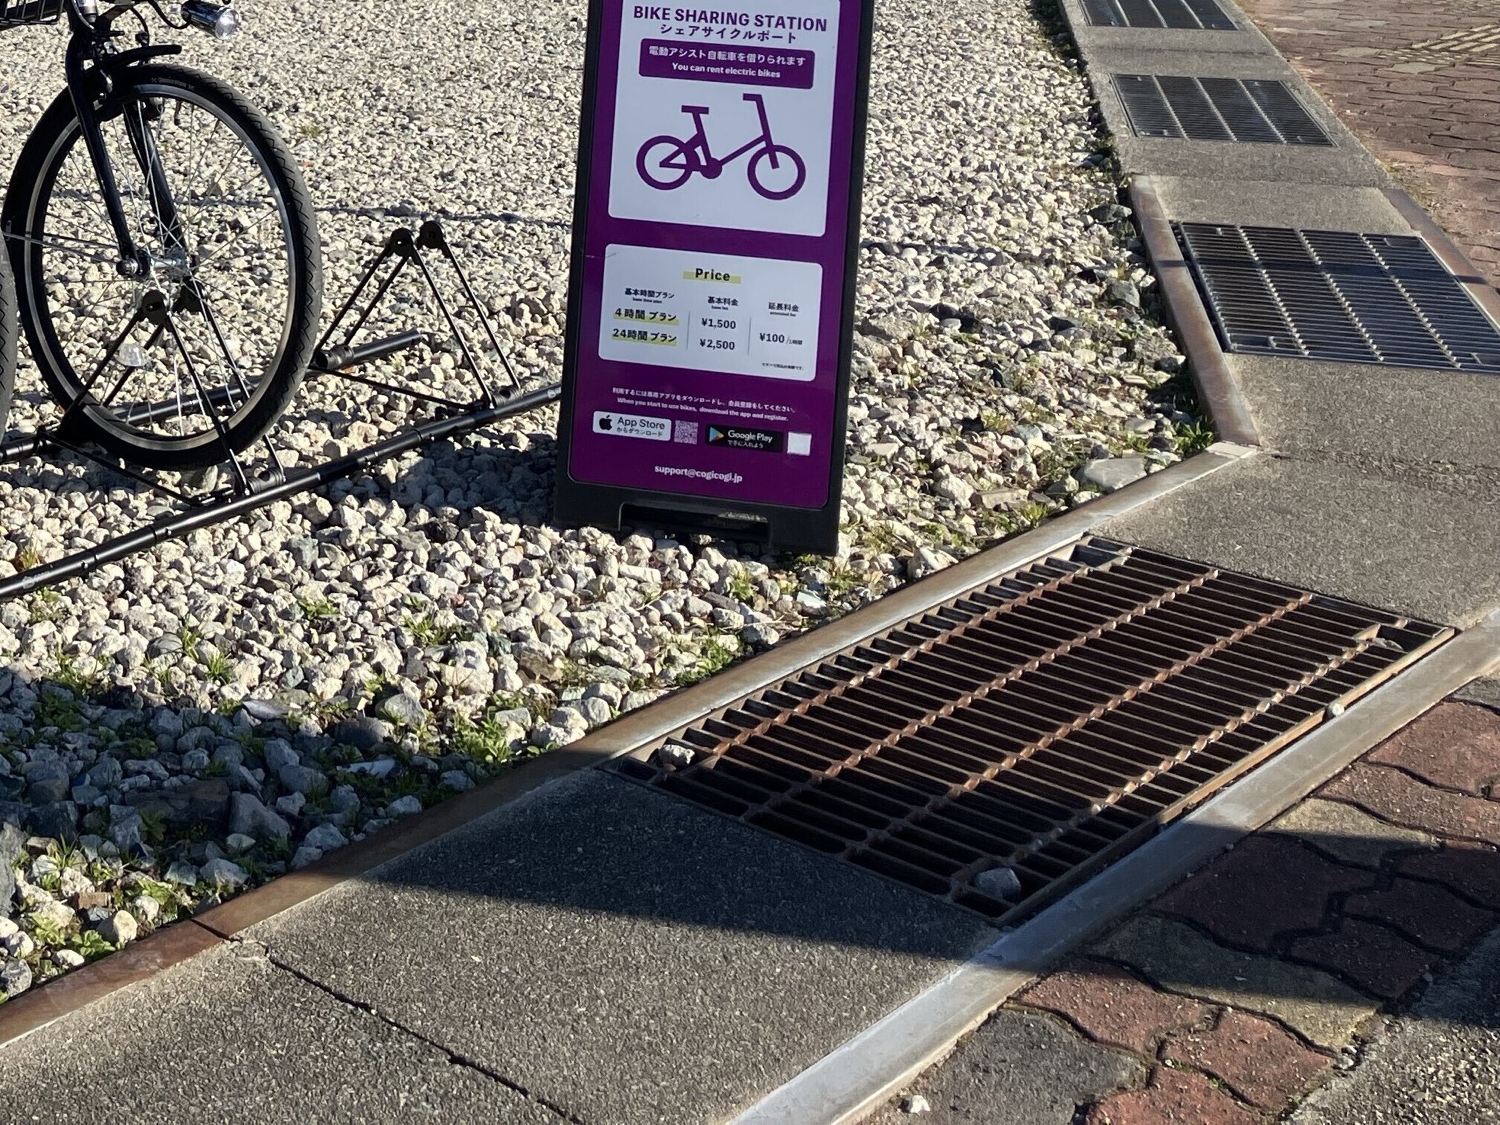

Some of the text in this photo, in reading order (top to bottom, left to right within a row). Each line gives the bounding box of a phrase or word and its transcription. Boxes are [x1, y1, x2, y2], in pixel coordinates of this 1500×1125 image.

[634, 6, 827, 31] BIKE SHARING STATION
[660, 24, 797, 44] シェアサイクルポート
[649, 46, 806, 67] 電動アシスト自転車を借りられます
[672, 62, 688, 71] You
[707, 65, 723, 74] rent
[725, 67, 756, 76] electric
[758, 69, 780, 78] bikes
[695, 268, 730, 282] Price
[707, 296, 739, 306] 基本料金
[701, 317, 736, 330] ¥1,500
[700, 338, 735, 350] ¥2,500
[617, 397, 634, 405] When
[699, 406, 728, 415] download
[740, 411, 751, 419] app
[617, 417, 665, 430] App Store
[617, 427, 662, 437] からダウンロード
[728, 430, 773, 443] Google Play
[655, 465, 742, 483] support@cogicogi.jp
